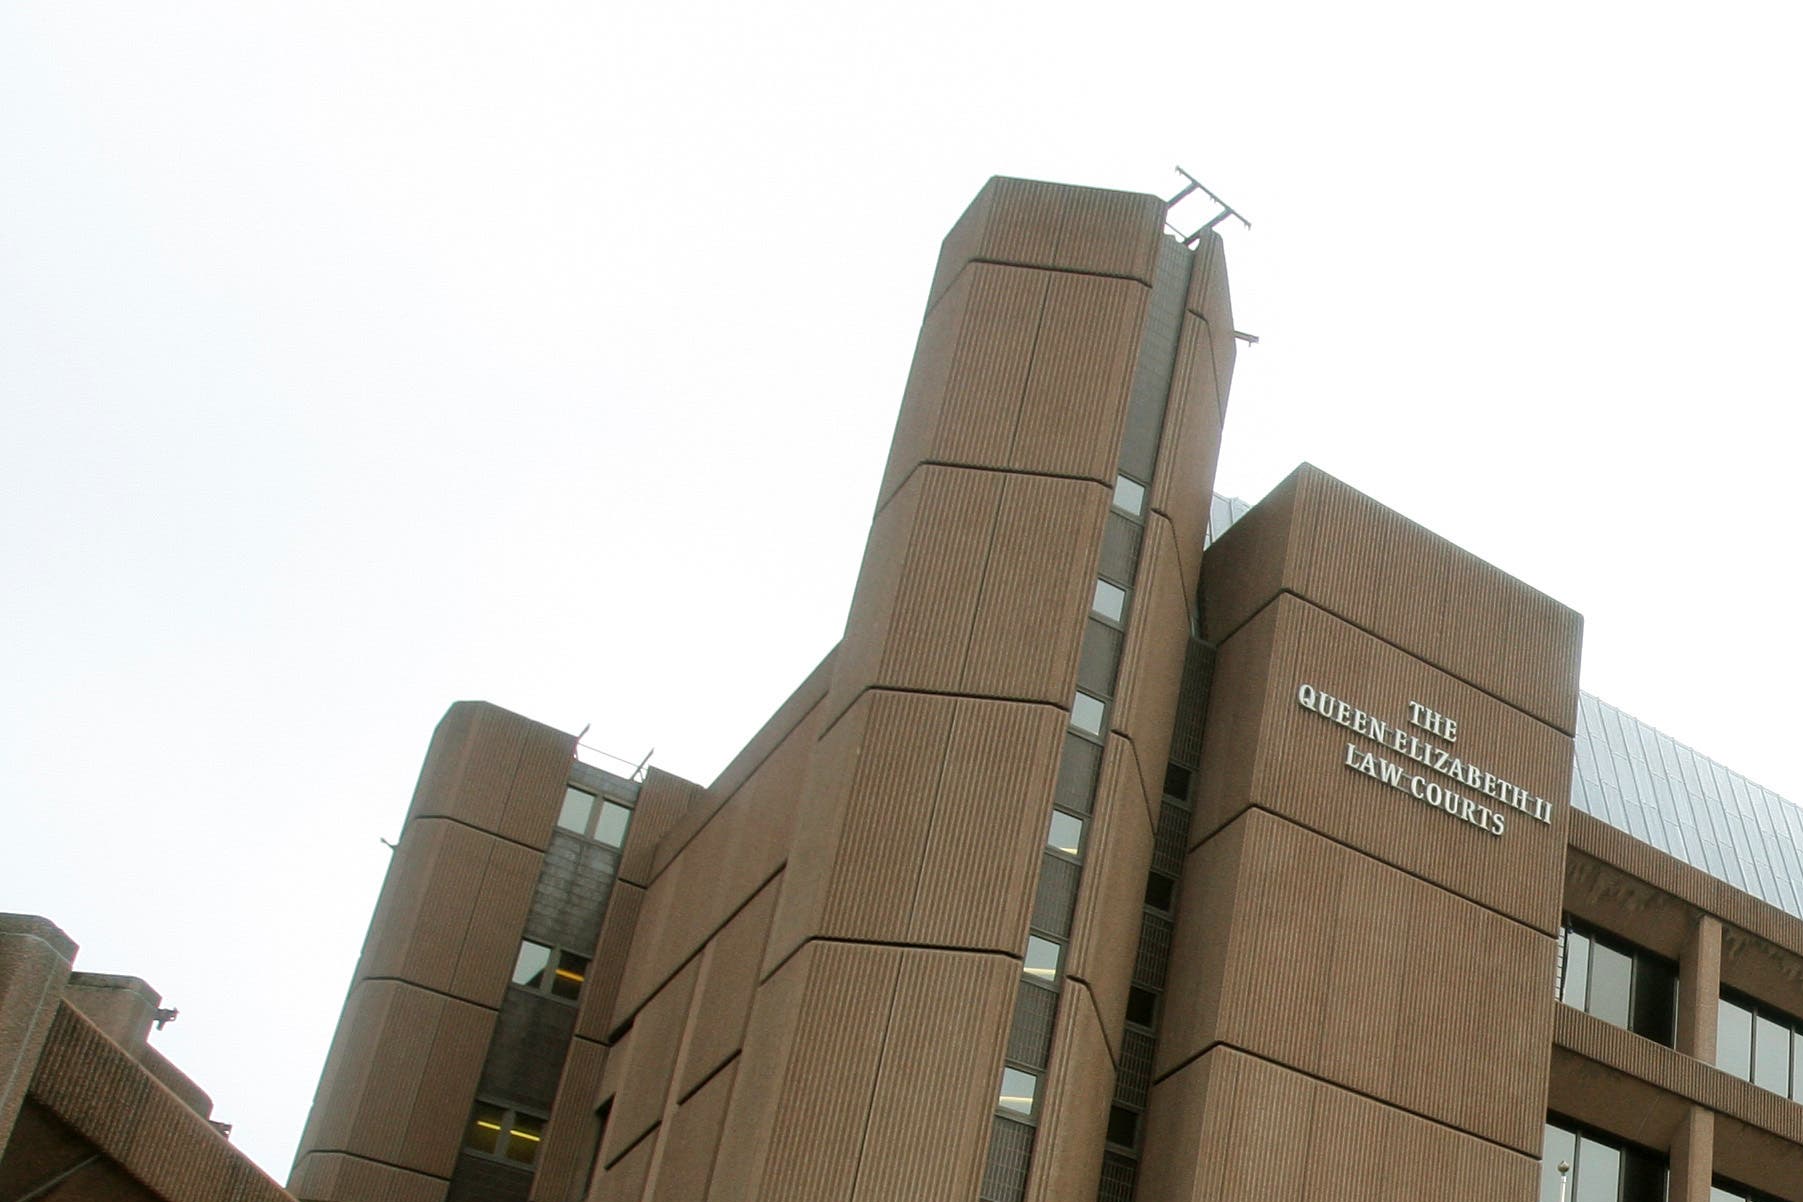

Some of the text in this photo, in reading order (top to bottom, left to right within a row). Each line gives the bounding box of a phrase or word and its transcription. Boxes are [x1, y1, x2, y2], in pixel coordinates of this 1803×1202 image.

[1298, 683, 1553, 825] QUEEN ELIZABETH II
[1408, 700, 1457, 742] THE
[1345, 743, 1505, 836] LAW COURTS
